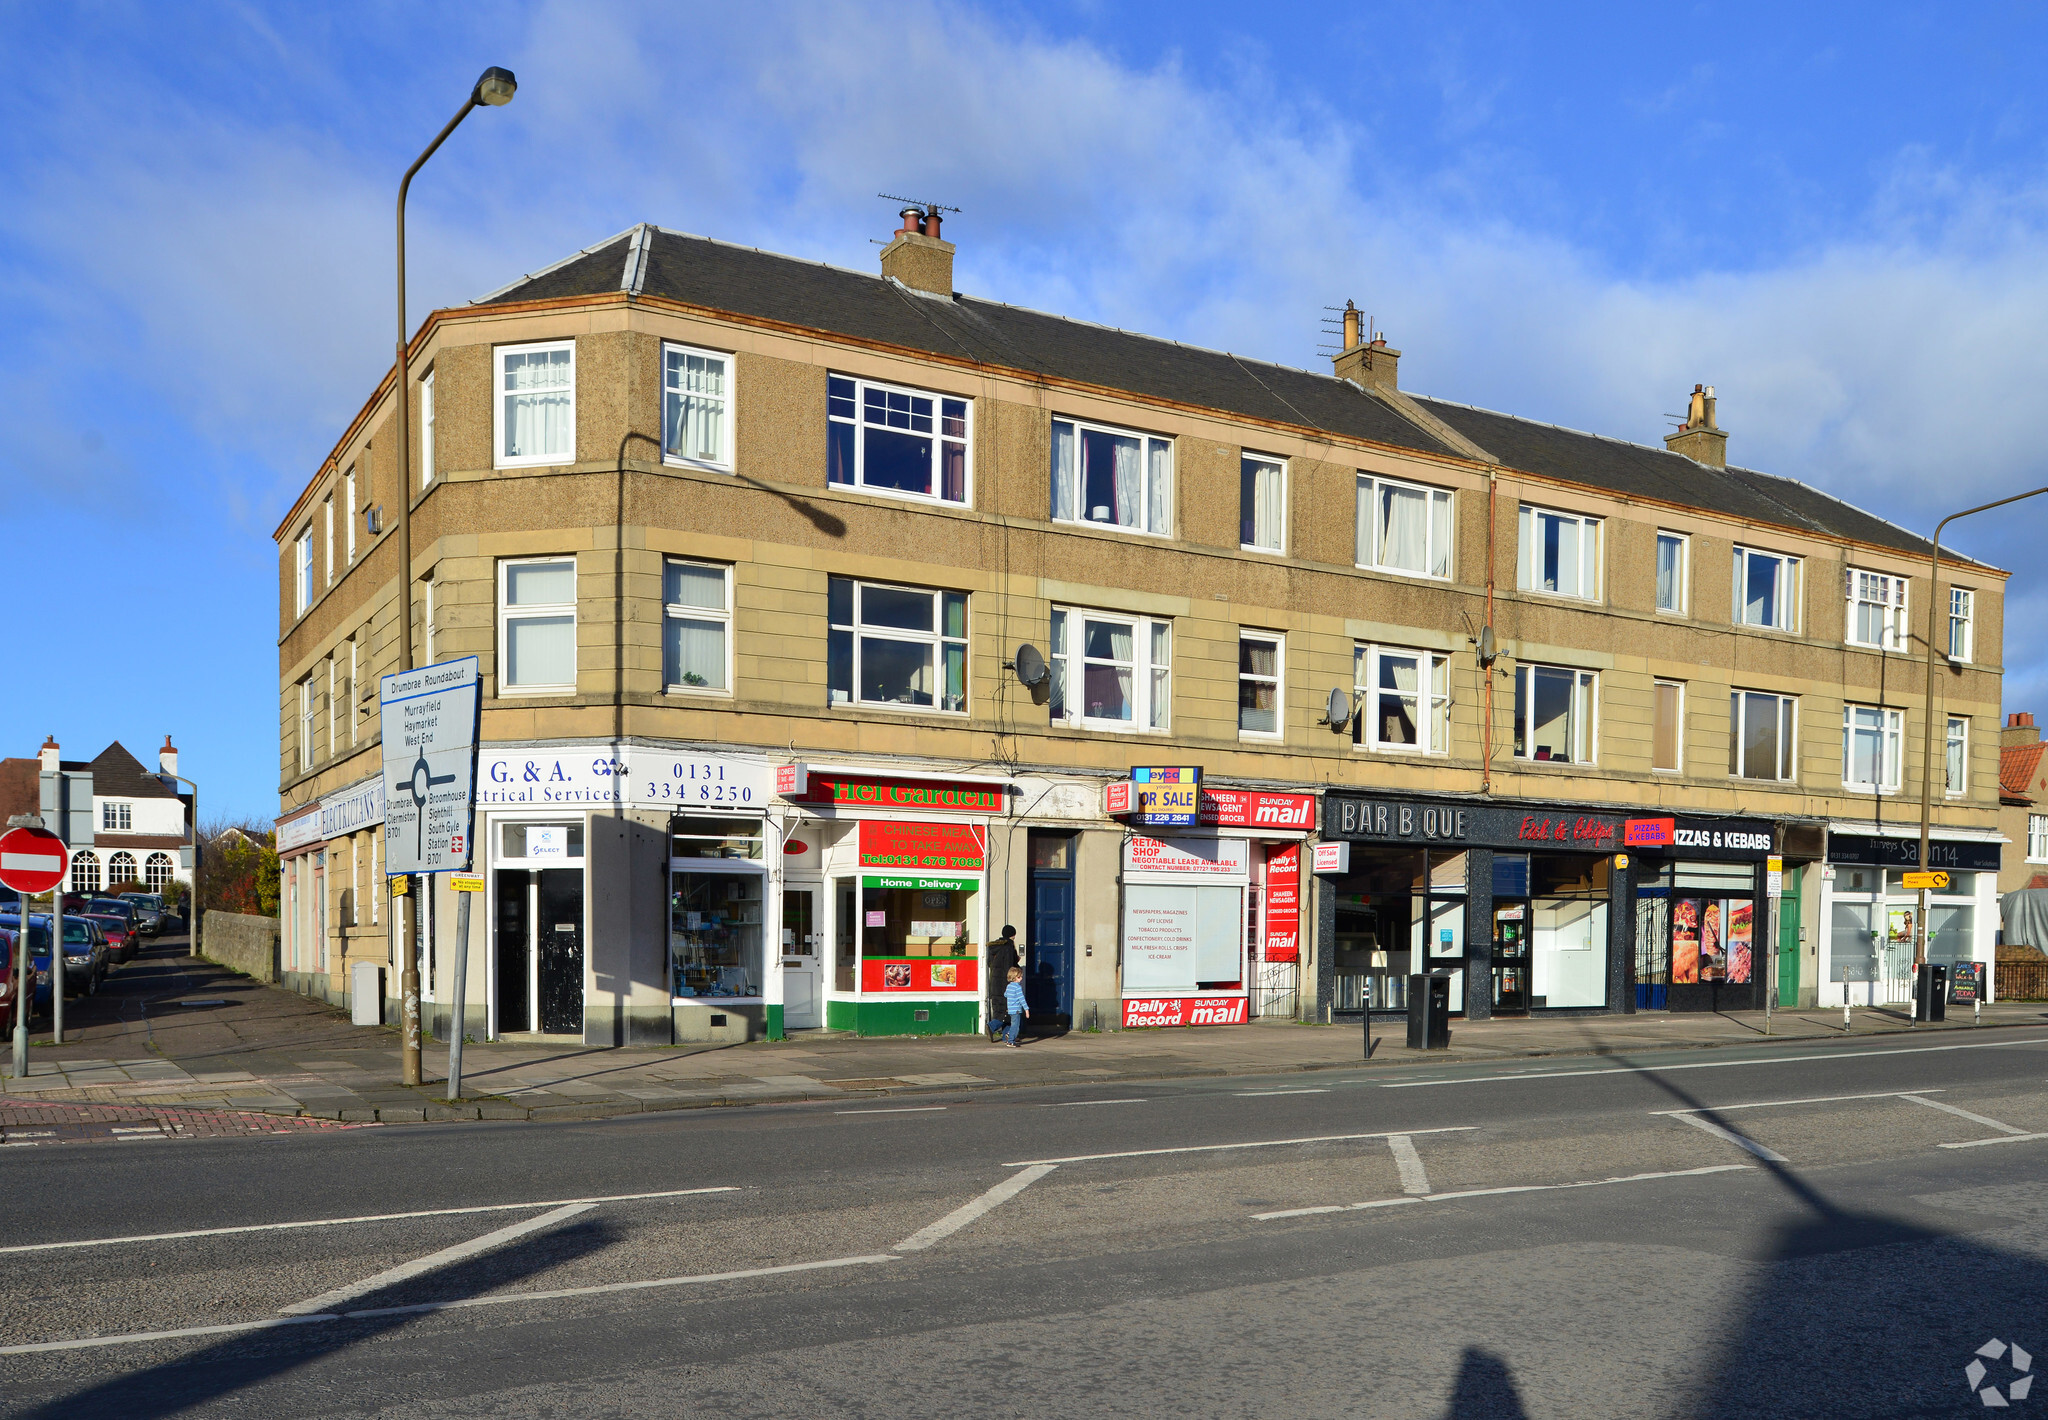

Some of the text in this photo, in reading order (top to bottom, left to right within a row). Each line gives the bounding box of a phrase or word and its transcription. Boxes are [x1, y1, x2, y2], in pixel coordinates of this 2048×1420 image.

[391, 667, 464, 694] Drumbrae Roundabout
[404, 700, 441, 717] Murrayfield
[404, 716, 438, 733] Haymarket
[404, 732, 433, 746] West End
[490, 760, 572, 783] G. & A.
[673, 763, 725, 780] 0131
[429, 791, 466, 805] Broomhouse
[476, 786, 620, 802] ctrical Services
[647, 782, 752, 802] 334 8250
[832, 779, 883, 801] Hei
[890, 783, 996, 807] Garden
[1201, 793, 1236, 803] SHAHEEN
[387, 798, 413, 810] Drumbrae
[1110, 798, 1126, 808] mail
[1138, 792, 1194, 806] OR SALE
[1259, 797, 1294, 806] SUNDAY
[322, 790, 374, 835] ELECTRICIANS
[429, 805, 453, 821] Sighthill
[1201, 802, 1243, 813] EWSAGENT
[1255, 800, 1310, 824] mail
[387, 812, 416, 824] Clermiston
[1200, 813, 1245, 822] ENSED GROCER
[1341, 801, 1466, 840] BAR B QUE
[387, 827, 401, 839] B701
[428, 820, 460, 836] South Gyle
[884, 824, 939, 837] CHINESE
[941, 827, 982, 839] MEALS
[1518, 816, 1614, 848] Fish & Chips
[1634, 823, 1661, 832] PIZZAS
[1132, 838, 1167, 848] RETAIL
[1628, 832, 1666, 841] & KEBABS
[1713, 831, 1722, 848] &
[1724, 832, 1771, 850] KEBABS
[427, 838, 448, 850] Station
[890, 839, 978, 853] TO TAKE AWAY
[1869, 838, 1898, 853] Turveys
[1132, 847, 1160, 856] SHOP
[1318, 849, 1326, 857] Off
[1943, 846, 1959, 866] 14
[427, 852, 442, 865] B701
[922, 856, 947, 866] 476
[951, 857, 982, 867] 7089
[1132, 857, 1176, 865] NEGOTIABLE
[1201, 859, 1238, 867] AVAILABLE
[1269, 856, 1291, 865] Daily
[1316, 858, 1338, 866] Licensed
[1269, 864, 1297, 873] Record
[880, 878, 963, 890] Home Delivery
[924, 894, 947, 904] OPEN
[1269, 896, 1296, 904] NEWSAGENT
[1273, 890, 1293, 898] SHAHEEN
[1267, 931, 1297, 948] mail
[1956, 990, 1976, 998] TODAY
[1126, 1000, 1169, 1015] Daily
[1194, 999, 1229, 1007] SUNDAY
[1190, 998, 1245, 1024] mail
[1126, 1012, 1183, 1027] Record
